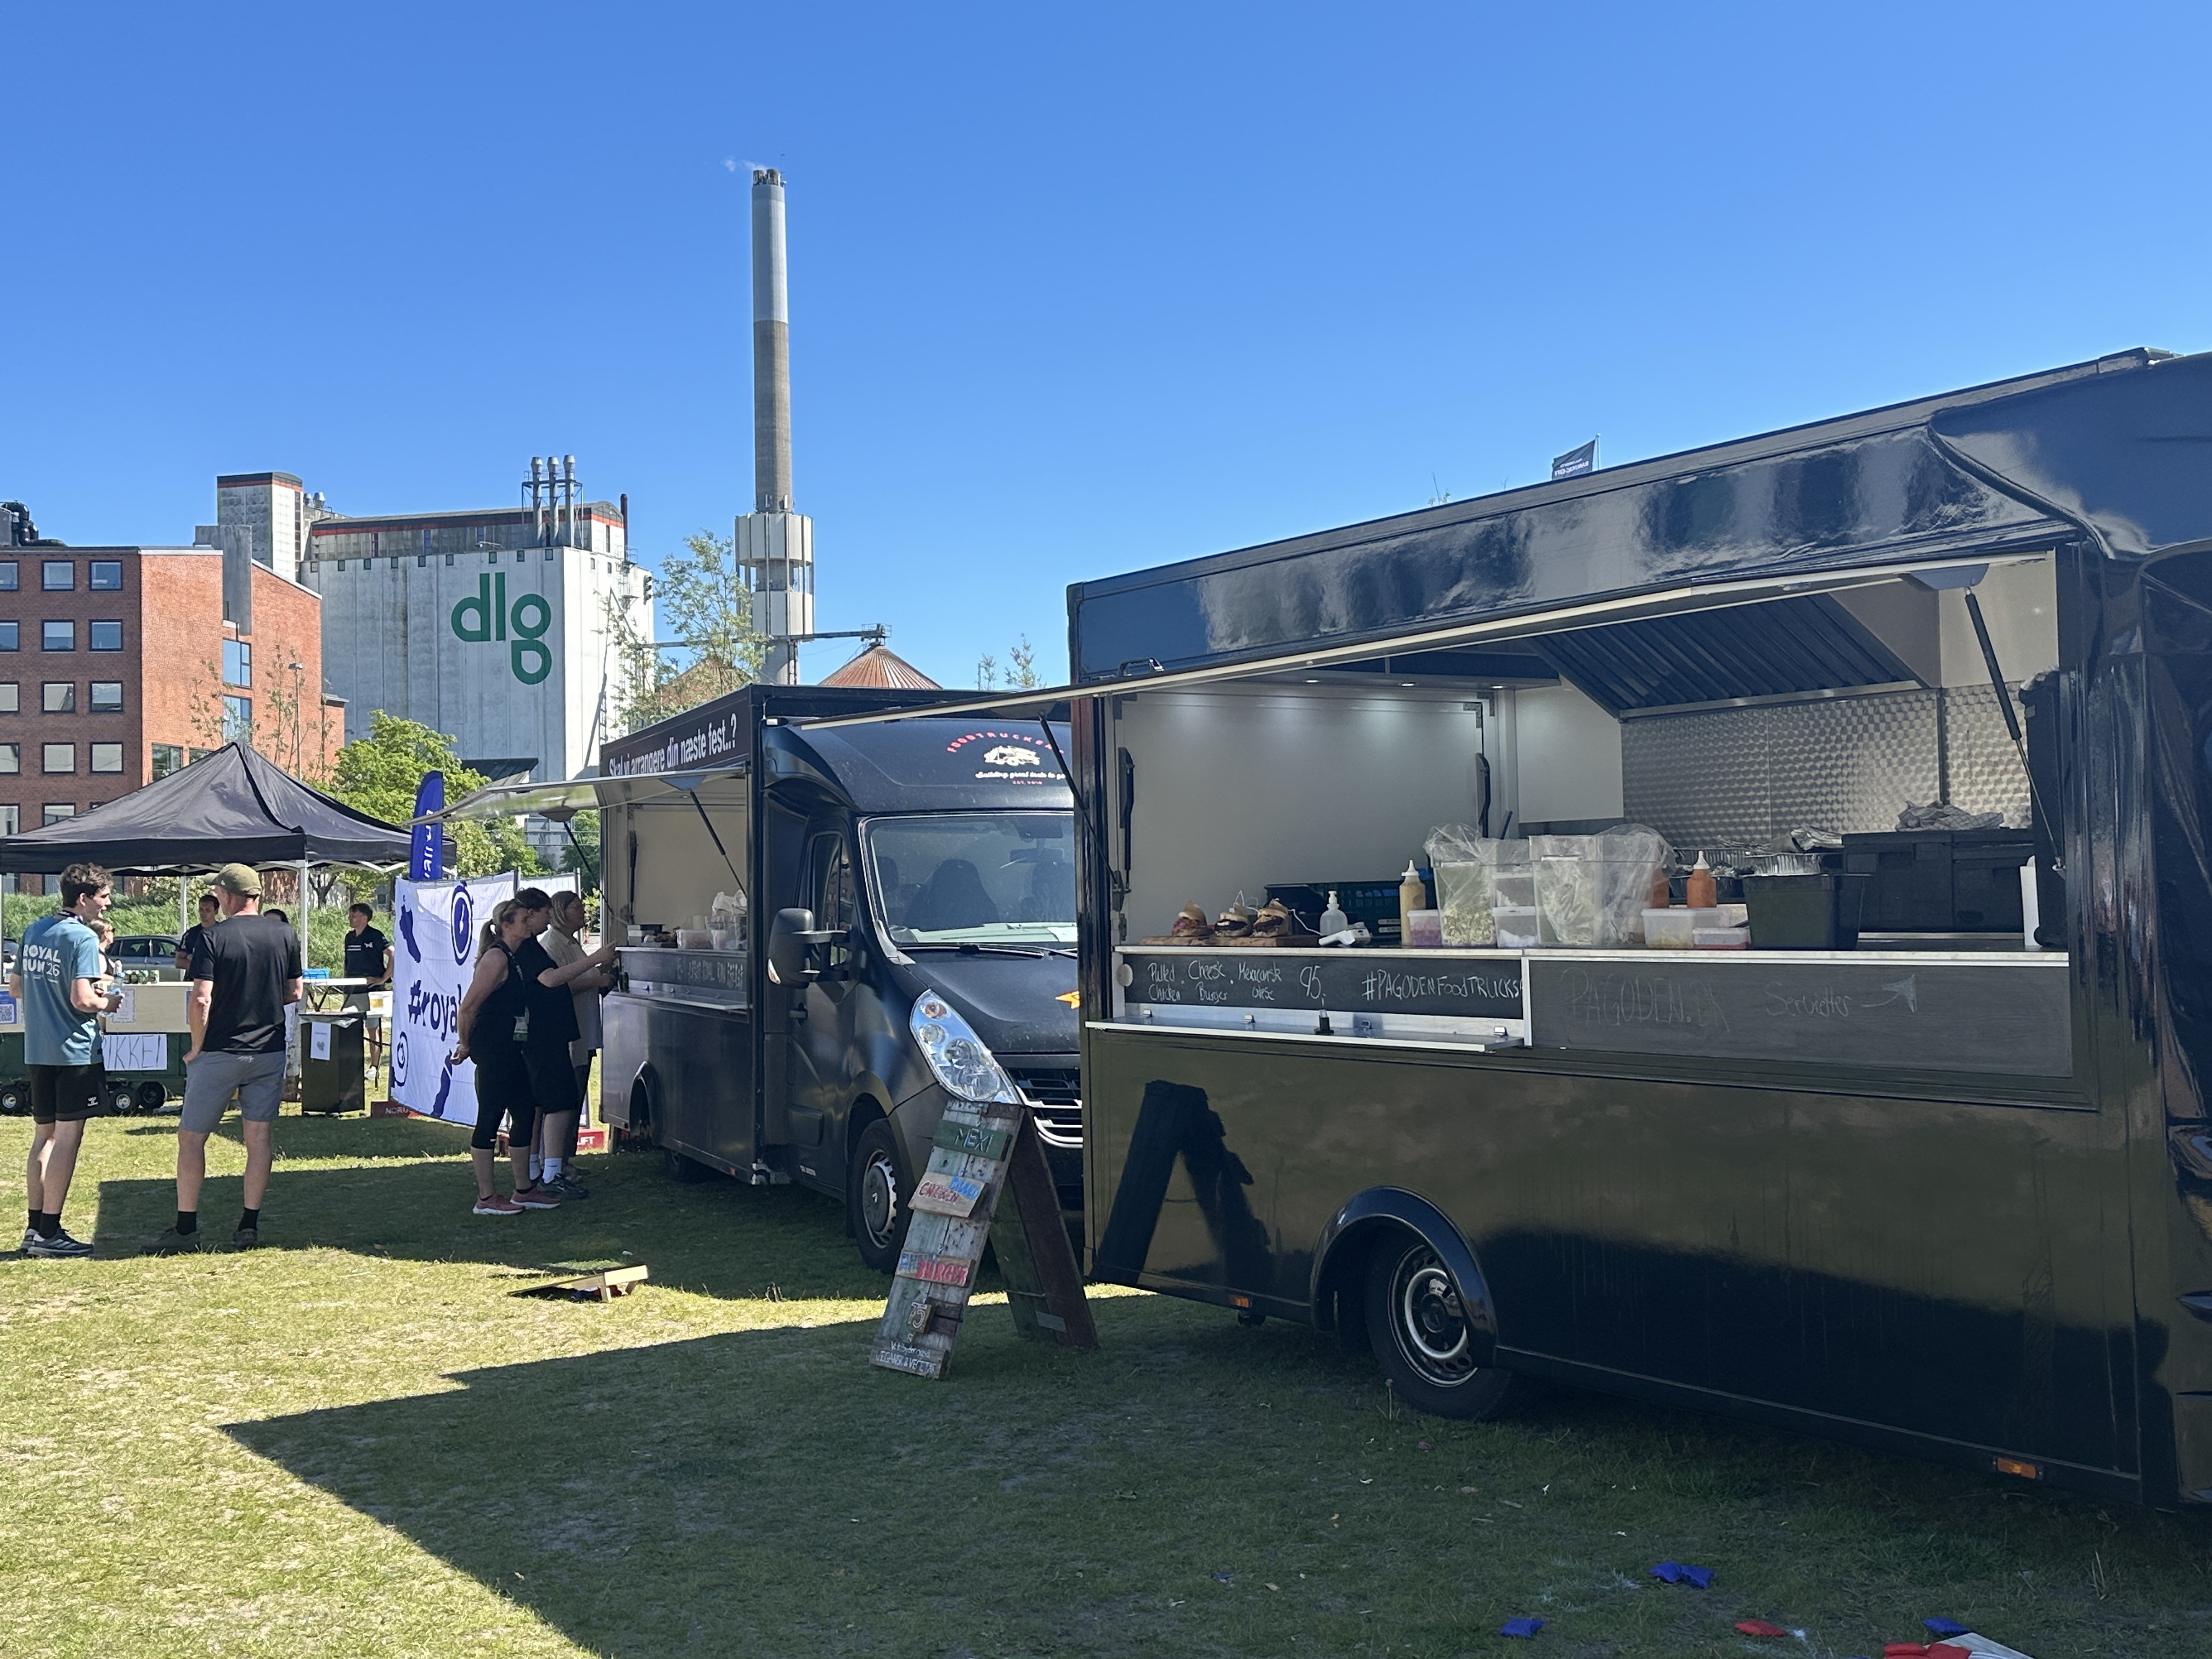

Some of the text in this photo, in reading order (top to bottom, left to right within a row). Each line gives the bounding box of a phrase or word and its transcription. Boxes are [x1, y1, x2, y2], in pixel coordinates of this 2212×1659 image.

[451, 572, 552, 685] dlg
[624, 753, 630, 775] vi
[631, 748, 665, 774] arrangere
[667, 736, 679, 769] din
[681, 729, 707, 764] næste
[1147, 962, 1175, 983] Pulled
[1148, 984, 1181, 1002] Chicken
[1195, 981, 1228, 1005] Burger
